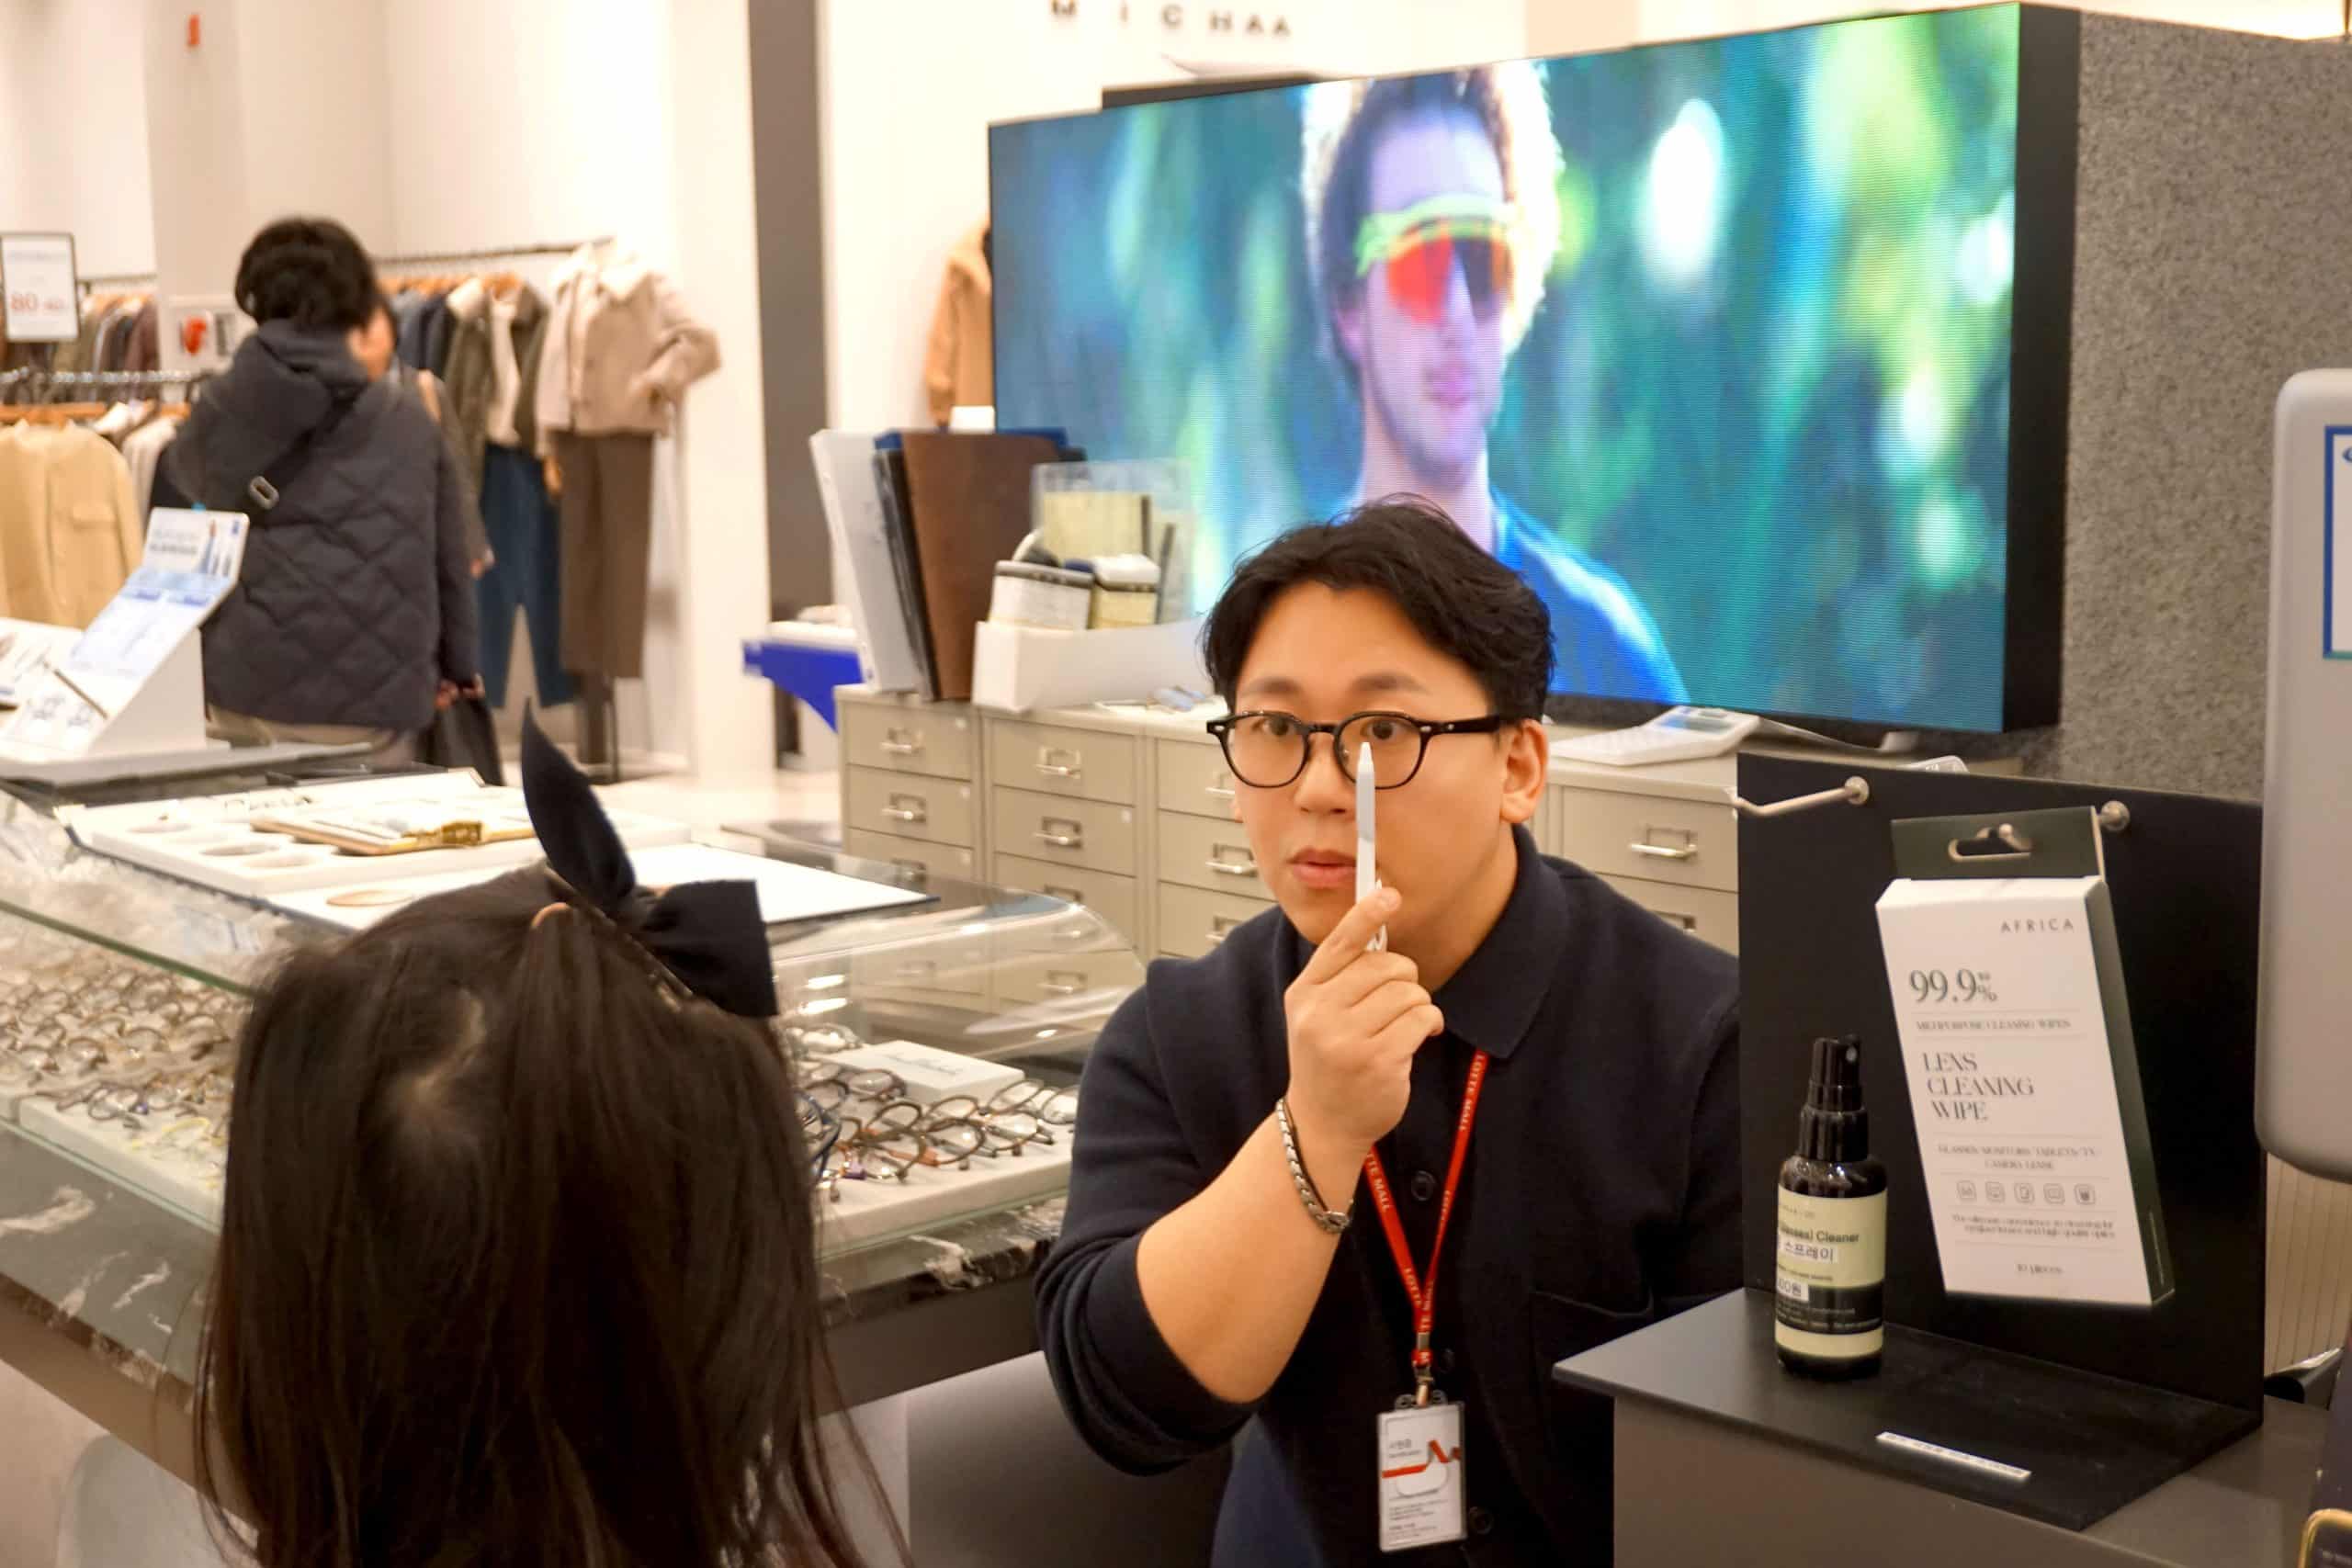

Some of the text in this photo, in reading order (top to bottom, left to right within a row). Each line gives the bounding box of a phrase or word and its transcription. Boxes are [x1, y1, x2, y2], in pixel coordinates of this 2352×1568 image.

[2000, 918, 2075, 933] AFRICA
[1922, 1052, 1978, 1072] LENS
[1927, 1077, 2035, 1096] CLEANING
[1931, 1100, 1988, 1122] WIPE
[1816, 1231, 1860, 1243] Cleaner
